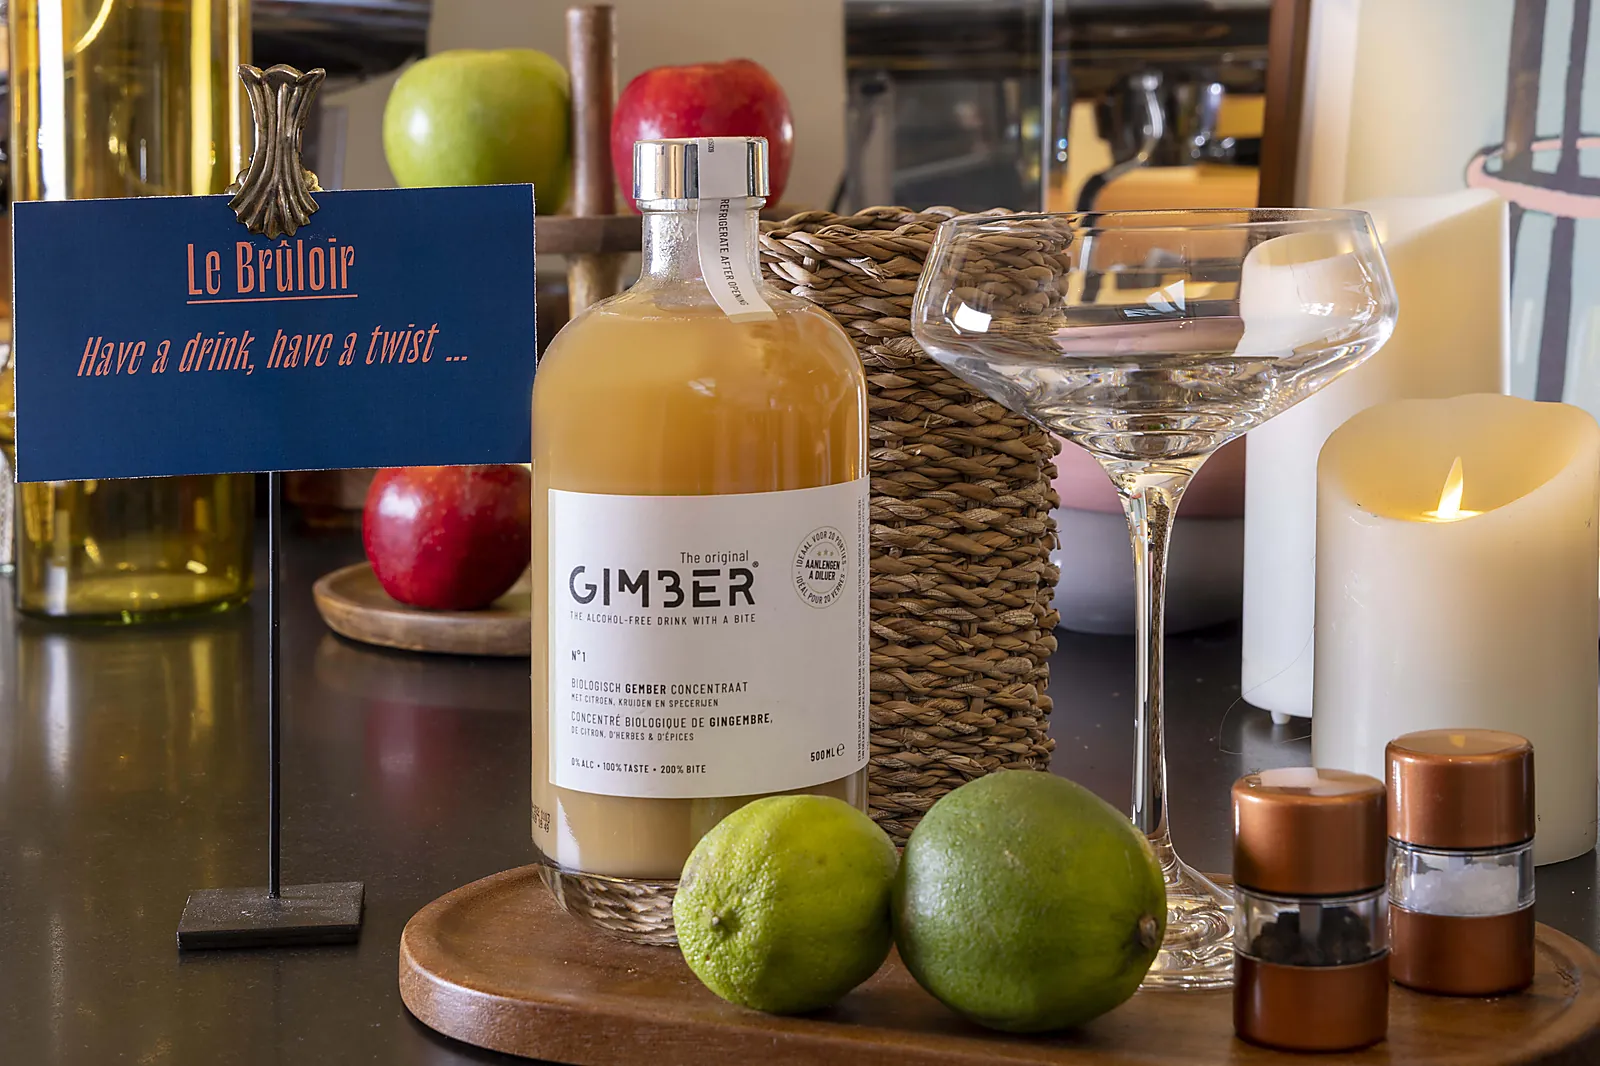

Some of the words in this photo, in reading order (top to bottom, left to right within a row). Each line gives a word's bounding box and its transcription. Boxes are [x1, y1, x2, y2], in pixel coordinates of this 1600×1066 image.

[718, 199, 730, 254] REFRIGERATE
[187, 242, 221, 295] Le
[236, 237, 355, 295] Brûloir
[721, 256, 735, 282] AFTER
[728, 280, 749, 306] OPENING
[77, 336, 146, 377] Have
[151, 341, 169, 374] a
[178, 330, 256, 376] drink,
[267, 329, 332, 370] have
[339, 332, 358, 366] a
[365, 322, 440, 365] twist
[680, 552, 700, 564] The
[704, 550, 749, 566] original
[796, 541, 813, 568] IDEAAL
[811, 530, 828, 543] VOOR
[828, 531, 836, 541] 20
[835, 535, 847, 565] PORTIES
[805, 559, 841, 570] AANLENGEN
[815, 571, 836, 581] DILUER
[569, 565, 756, 608] GIMBER
[807, 592, 823, 604] POUR
[824, 594, 831, 604] 20
[831, 574, 846, 599] VERRES
[570, 611, 583, 621] THE
[586, 613, 652, 626] ALCOHOL-FREE
[657, 616, 687, 626] DRINK
[693, 615, 717, 625] WITH
[723, 615, 729, 624] A
[734, 613, 756, 624] BITE
[571, 678, 621, 693] BIOLOGISCH
[625, 684, 667, 695] GEMBER
[671, 681, 748, 695] CONCENTRAAT
[571, 693, 583, 702] MET
[584, 694, 616, 706] CITROEN,
[618, 698, 652, 708] KRUIDEN
[655, 699, 666, 708] EN
[669, 698, 719, 708] SPECERIJEN
[571, 710, 621, 727] CONCENTRÉ
[625, 716, 687, 729] BIOLOGIQUE
[691, 717, 705, 728] DE
[709, 712, 773, 727] GINGEMBRE,
[571, 725, 579, 735] DE
[580, 727, 606, 739] CITRON,
[609, 730, 645, 741] D'HERBES
[648, 732, 654, 741] &
[657, 732, 694, 742] D'ÉPICES
[810, 747, 835, 762] 500ML
[581, 759, 594, 769] ALC
[603, 762, 622, 772] 100%
[624, 763, 649, 774] TASTE
[660, 765, 684, 774] 200%
[686, 764, 706, 774] BITE
